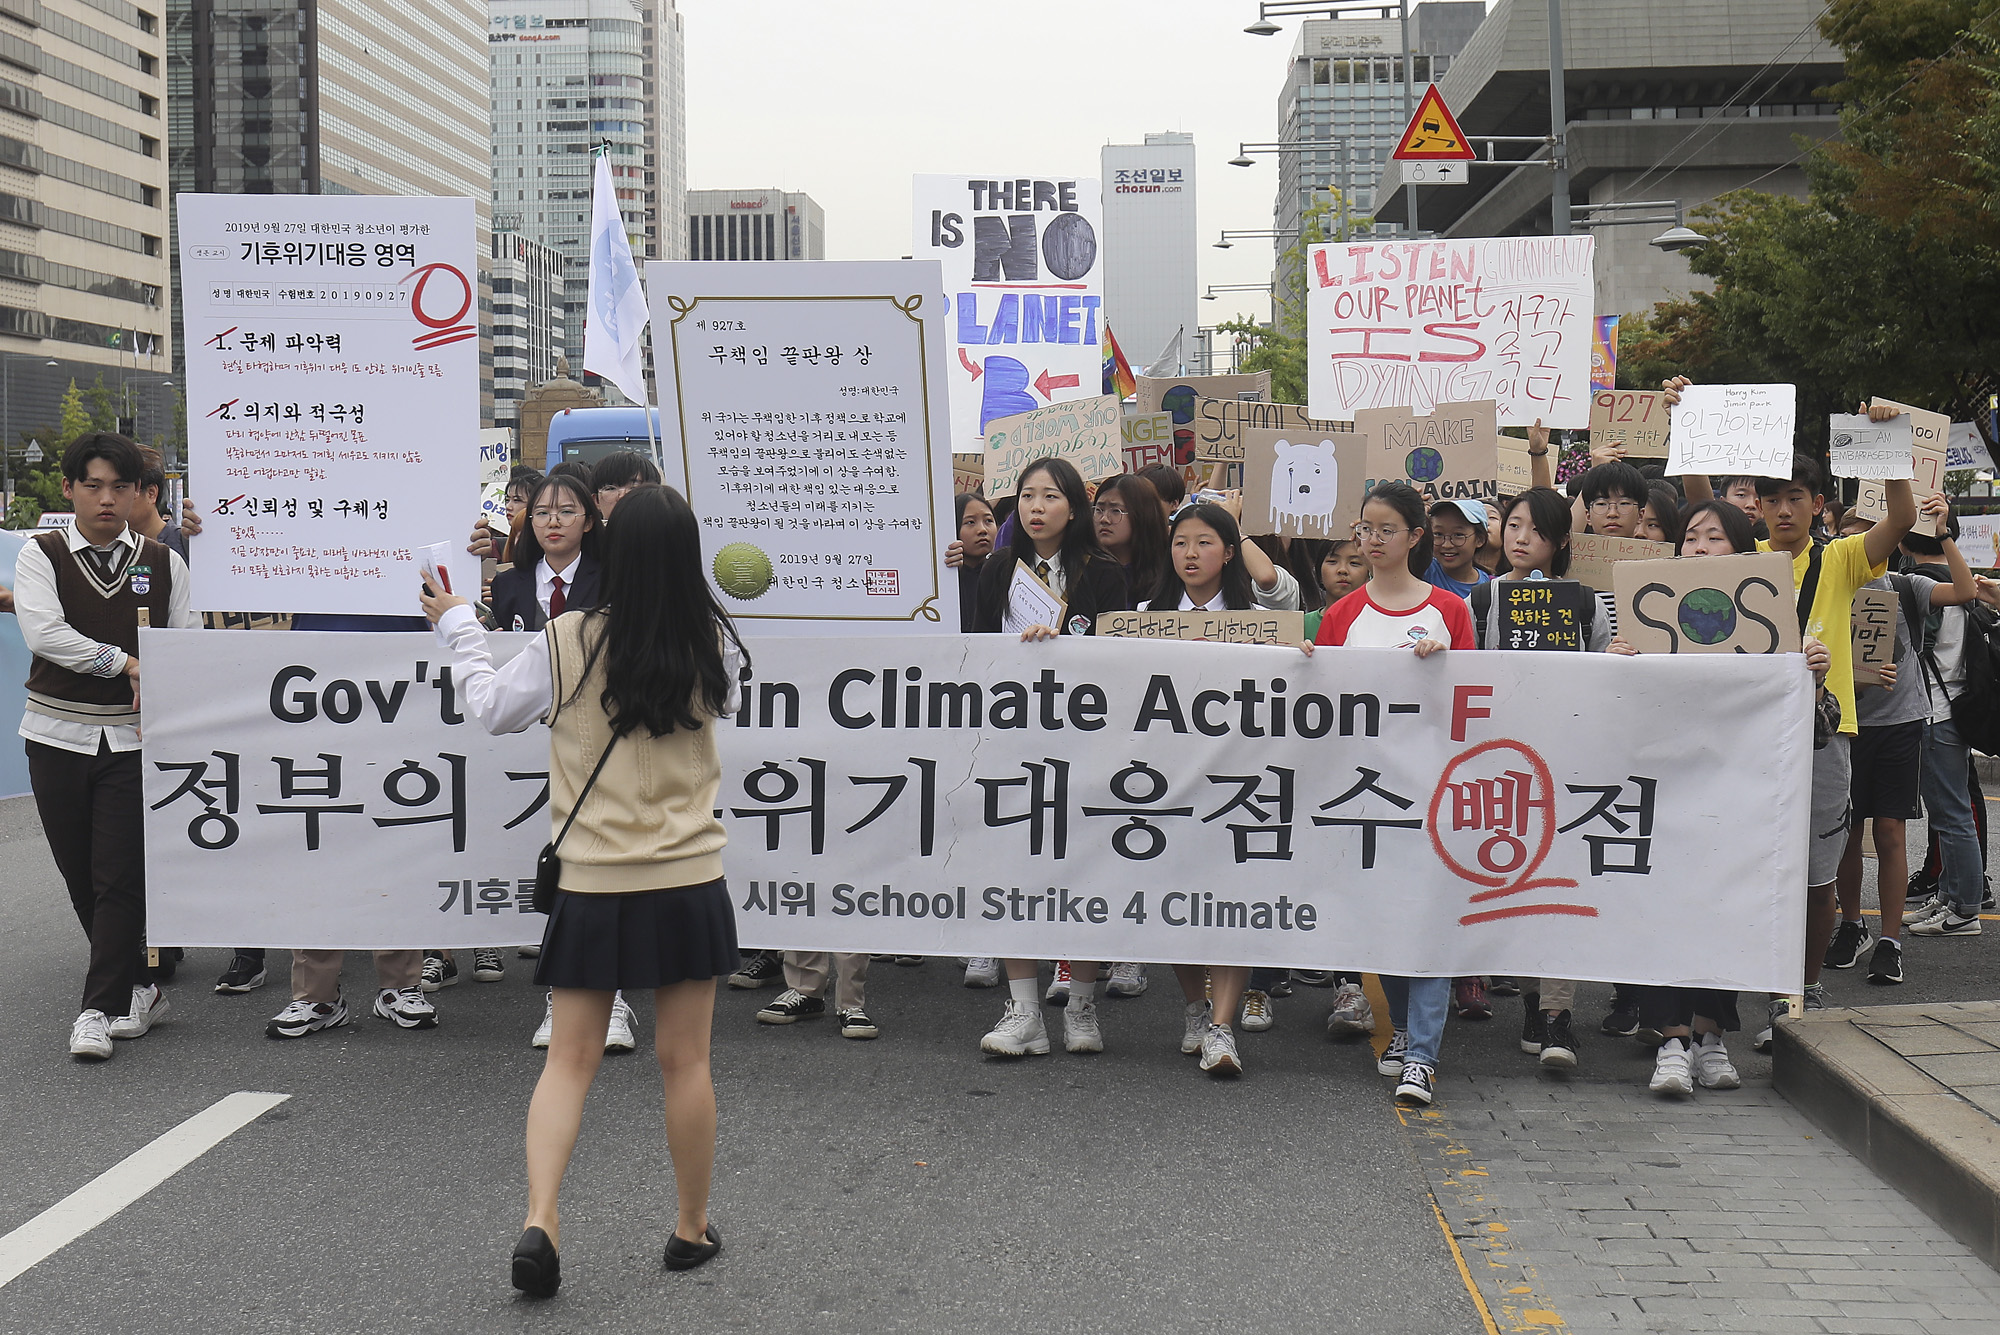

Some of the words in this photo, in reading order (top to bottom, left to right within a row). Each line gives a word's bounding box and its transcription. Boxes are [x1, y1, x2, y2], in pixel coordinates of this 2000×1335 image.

[1114, 168, 1184, 184] 조선일보
[968, 179, 1079, 212] THERE
[1115, 183, 1182, 194] chosun.com
[731, 200, 762, 209] kobaco
[225, 222, 260, 233] 2019년
[264, 222, 280, 233] 9월
[284, 223, 306, 234] 27일
[311, 223, 351, 234] 대한민국
[356, 224, 394, 235] 청소년이
[400, 224, 430, 235] 평가한
[931, 210, 965, 248] IS
[971, 212, 1097, 281] NO
[241, 242, 367, 266] 기후위기대응
[374, 243, 415, 267] 영역
[1313, 243, 1475, 288] LISTEN
[1482, 237, 1593, 282] GOVERNMENT!
[237, 289, 270, 299] 대한민국
[278, 289, 315, 299] 수험번호
[1334, 286, 1398, 322] OUR
[944, 292, 1101, 345] LANET
[1501, 294, 1575, 332] 지구가
[713, 321, 746, 331] 927호
[240, 332, 275, 353] 문제
[285, 333, 340, 354] 파악력
[1329, 322, 1487, 362] IS
[708, 345, 767, 365] 무책임
[780, 345, 843, 365] 끝판왕
[853, 345, 872, 365] 상
[1495, 331, 1562, 375] 죽고
[222, 360, 243, 374] 현실
[246, 361, 290, 373] 타협하며
[294, 361, 325, 374] 기후위기
[1332, 361, 1492, 411] DYING
[1725, 388, 1748, 400] Harry
[980, 356, 1038, 436] B
[1723, 400, 1747, 408] Jimin
[244, 402, 302, 423] 의지와
[309, 403, 363, 424] 적극성
[1597, 393, 1656, 423] 927
[715, 412, 749, 424] 국가는
[751, 412, 797, 424] 무책임한
[800, 412, 822, 424] 기후
[825, 412, 871, 424] 정책으로
[873, 412, 905, 424] 학교에
[1083, 407, 1117, 428] OUR
[1680, 408, 1790, 439] 인간이라서
[226, 430, 244, 438] 파리
[248, 429, 281, 441] 협약에
[715, 429, 748, 441] 있어야
[764, 430, 809, 442] 청소년을
[812, 430, 846, 442] 거리로
[848, 430, 883, 442] 내모는
[1011, 414, 1080, 446] WORLD
[1384, 418, 1474, 450] MAKE
[1593, 429, 1627, 447] 기후를
[1634, 430, 1660, 447] 위한
[1854, 431, 1871, 444] I
[1875, 431, 1892, 444] AM
[226, 447, 270, 460] 부족하면서
[373, 452, 398, 460] 지키지
[707, 447, 750, 459] 무책임의
[754, 448, 811, 460] 끝판왕으로
[813, 448, 859, 460] 불리어도
[861, 448, 907, 460] 손색없는
[1678, 442, 1791, 469] 부끄럽습니다
[717, 465, 751, 477] 모습을
[753, 465, 819, 478] 보여주었기에
[837, 466, 860, 478] 상을
[1834, 466, 1843, 475] A
[1850, 466, 1895, 477] HUMAN
[720, 482, 774, 494] 기후위기에
[778, 483, 801, 495] 대한
[803, 483, 824, 495] 책임
[829, 483, 851, 495] 있는
[854, 483, 899, 495] 대응으로
[1424, 478, 1497, 501] AGAIN
[241, 495, 296, 518] 신뢰성
[308, 498, 323, 518] 및
[333, 499, 387, 520] 구체성
[746, 500, 800, 512] 청소년들의
[805, 501, 838, 513] 미래를
[841, 501, 875, 513] 지키는
[703, 516, 723, 528] 책임
[727, 517, 770, 529] 끝판왕이
[788, 518, 810, 530] 것을
[813, 518, 844, 530] 바라며
[863, 518, 885, 530] 상을
[888, 518, 922, 530] 수여함
[352, 549, 388, 558] 바라보지
[1618, 541, 1634, 554] be
[1641, 543, 1662, 556] the
[780, 554, 818, 565] 2019년
[825, 554, 841, 565] 9월
[848, 554, 872, 565] 27일
[273, 564, 304, 576] 보호하지
[308, 565, 331, 578] 못하는
[1508, 588, 1553, 605] 우리가
[1510, 609, 1551, 626] 원하는
[1558, 609, 1573, 625] 건
[1510, 630, 1540, 648] 공감
[1547, 631, 1576, 646] 아닌
[269, 660, 465, 724] Gov't
[828, 666, 1108, 731] Climate
[1450, 684, 1494, 742] F
[150, 750, 468, 853] 정부의
[831, 883, 965, 919] School
[981, 886, 1108, 924] Strike
[1122, 890, 1147, 924] 4
[1160, 890, 1318, 931] Climate
